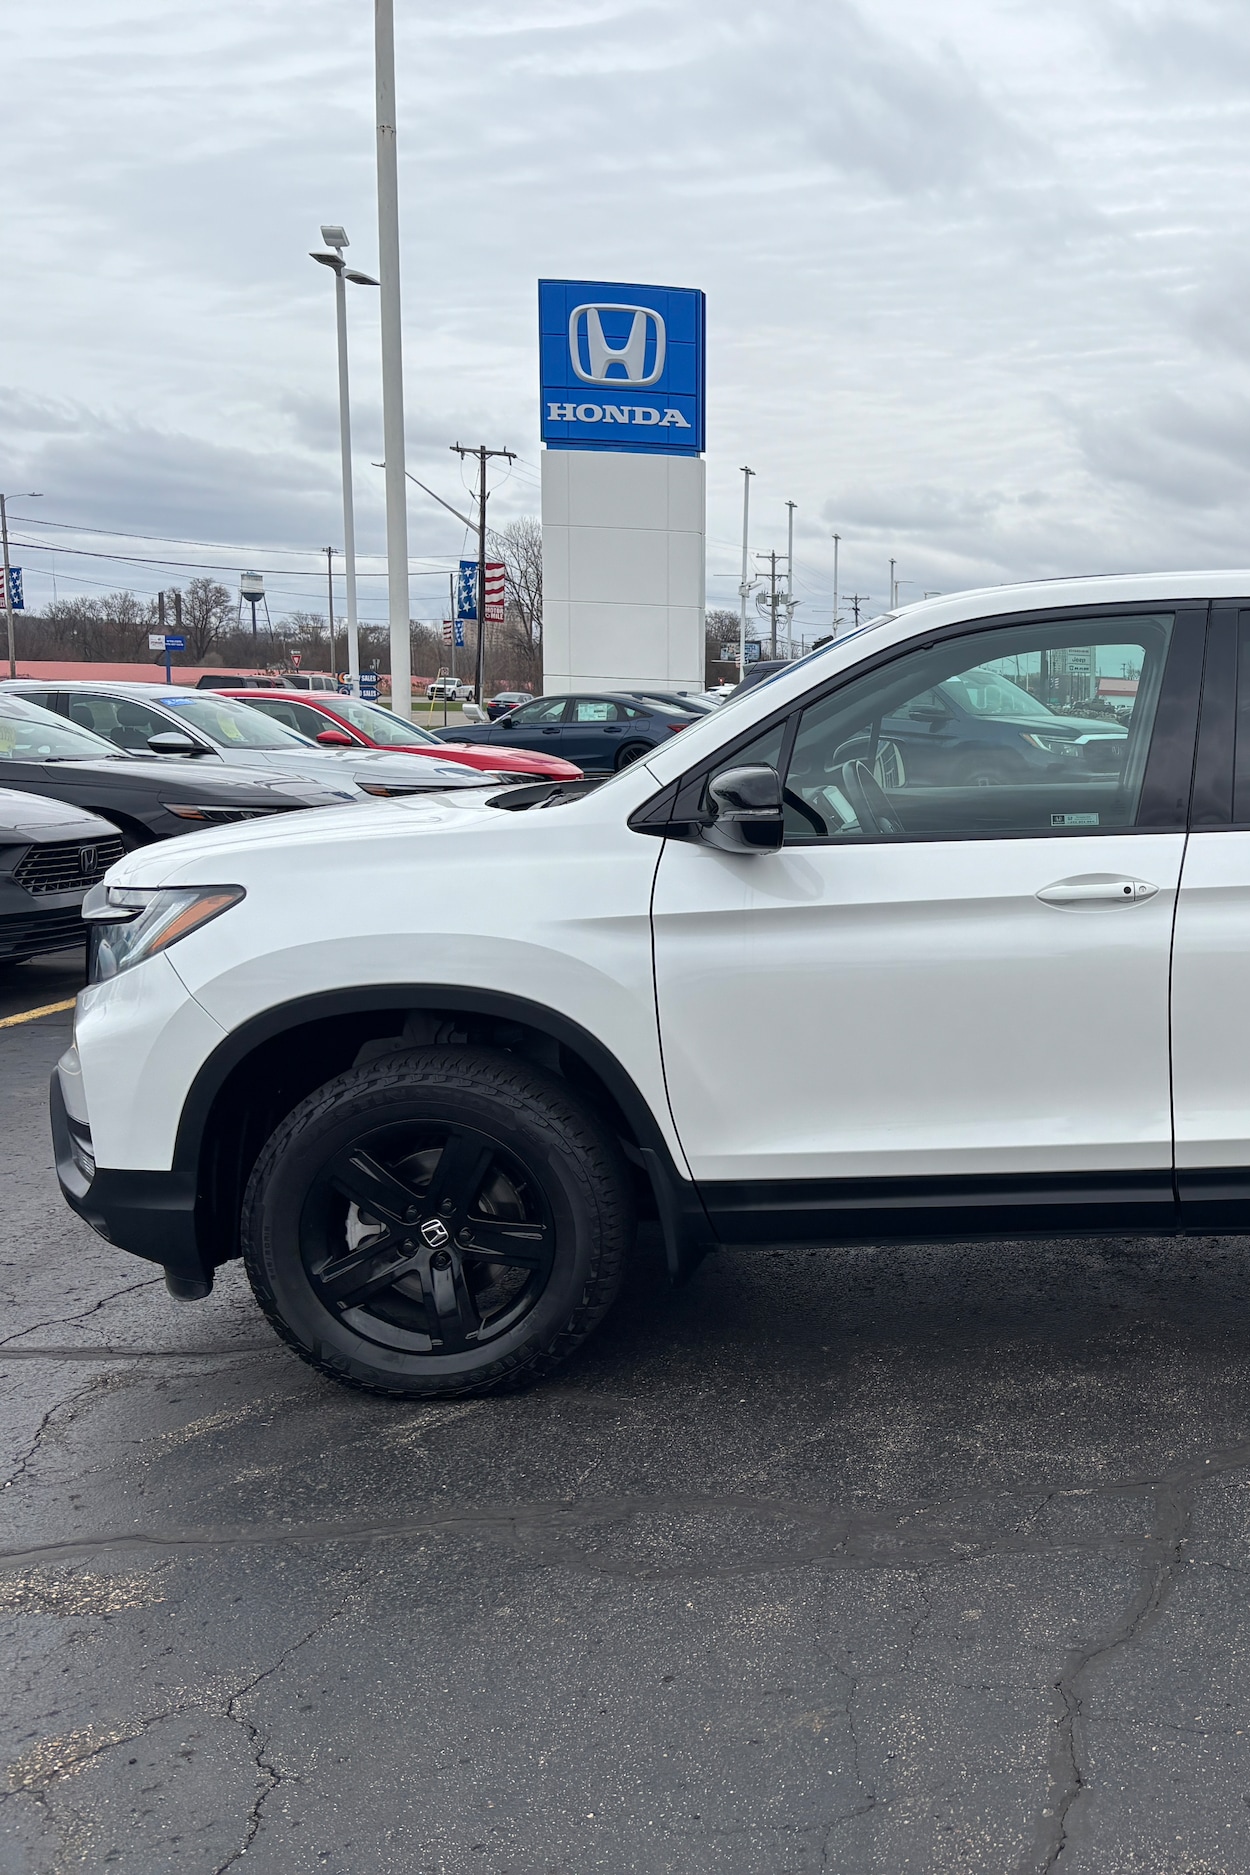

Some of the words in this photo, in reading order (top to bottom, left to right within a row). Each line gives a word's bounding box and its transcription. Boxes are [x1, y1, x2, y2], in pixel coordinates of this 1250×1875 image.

[547, 402, 691, 428] HONDA
[485, 606, 504, 614] MOTOR
[490, 612, 504, 620] MILE
[1072, 656, 1086, 664] Jeep
[361, 674, 376, 682] SALES
